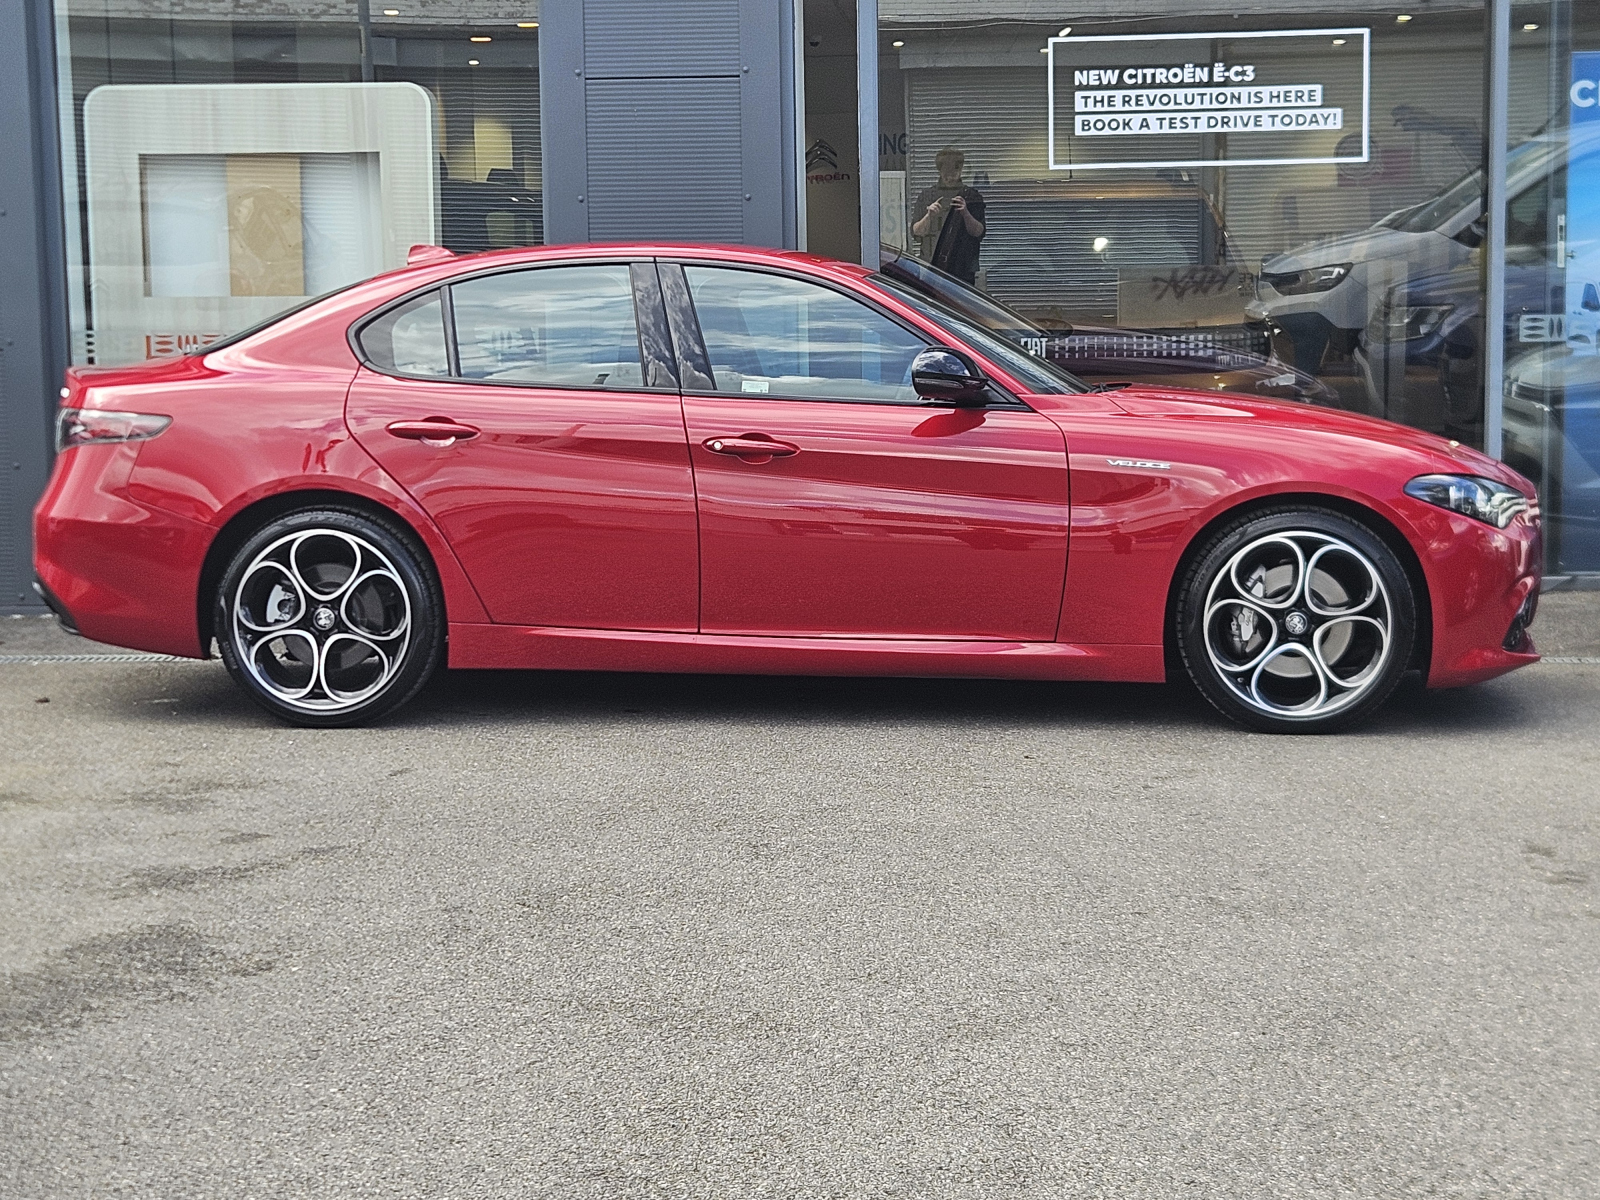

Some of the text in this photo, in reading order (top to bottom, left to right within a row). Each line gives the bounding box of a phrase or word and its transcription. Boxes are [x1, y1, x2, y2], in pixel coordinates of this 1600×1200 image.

[1074, 63, 1256, 86] NEW CITROËN Ë-C3
[1081, 89, 1317, 108] THE REVOLUTION IS HERE
[1569, 79, 1600, 108] C
[1081, 112, 1338, 132] BOOK A TEST DRIVE TODAY!
[1106, 459, 1171, 470] VELOCE
